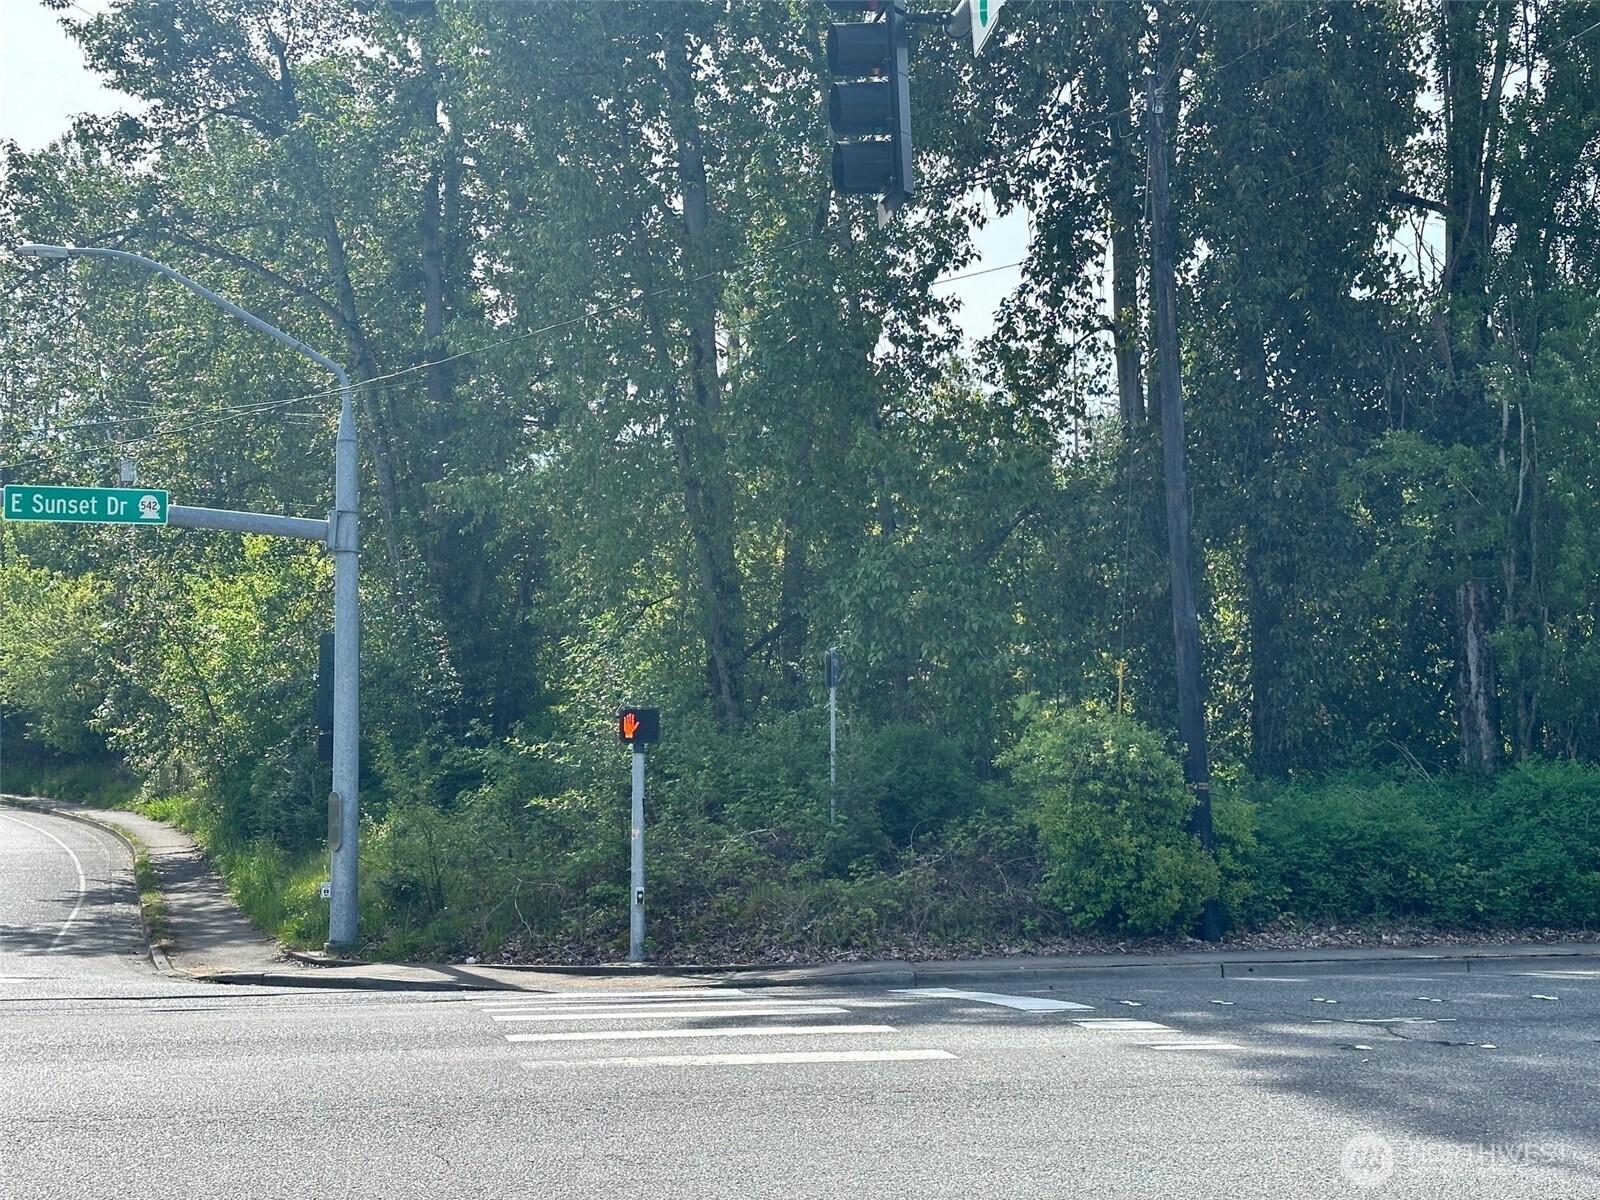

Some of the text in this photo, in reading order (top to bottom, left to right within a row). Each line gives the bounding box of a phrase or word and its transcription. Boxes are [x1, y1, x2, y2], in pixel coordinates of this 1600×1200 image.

[11, 493, 157, 516] E Sunset Dr 542
